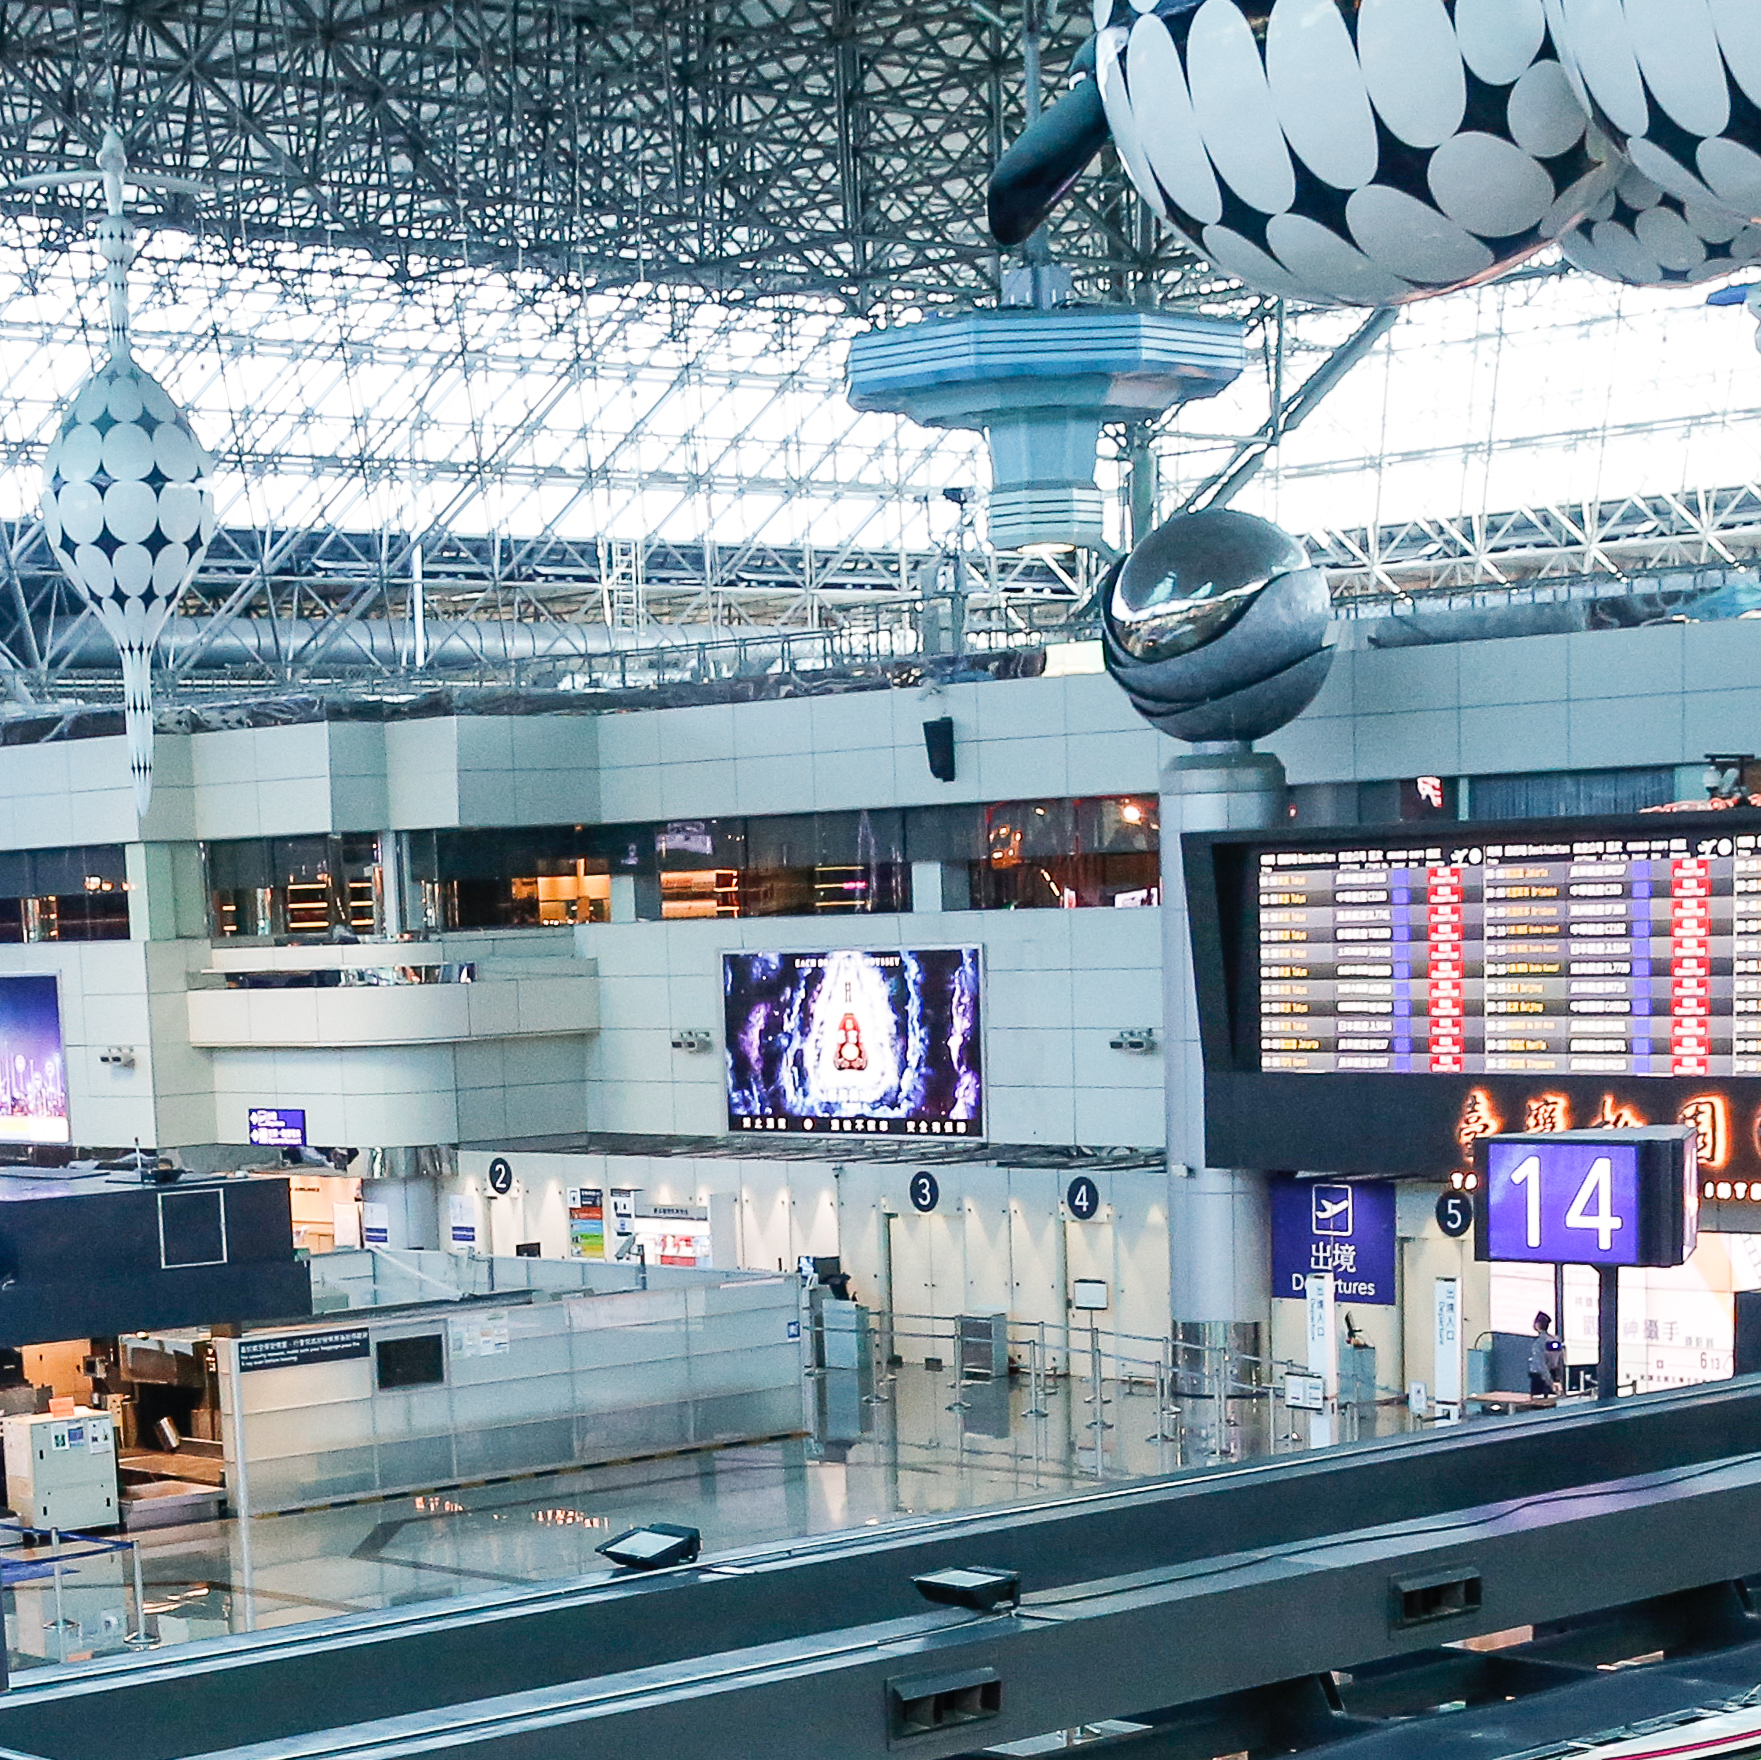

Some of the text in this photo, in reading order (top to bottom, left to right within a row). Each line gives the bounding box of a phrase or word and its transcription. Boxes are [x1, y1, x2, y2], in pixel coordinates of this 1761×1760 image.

[495, 1164, 507, 1188] 2
[918, 1178, 931, 1205] 3
[1074, 1184, 1089, 1212] 4
[1510, 1156, 1623, 1250] 14
[1446, 1199, 1462, 1228] 5
[1310, 1241, 1357, 1273] 出境
